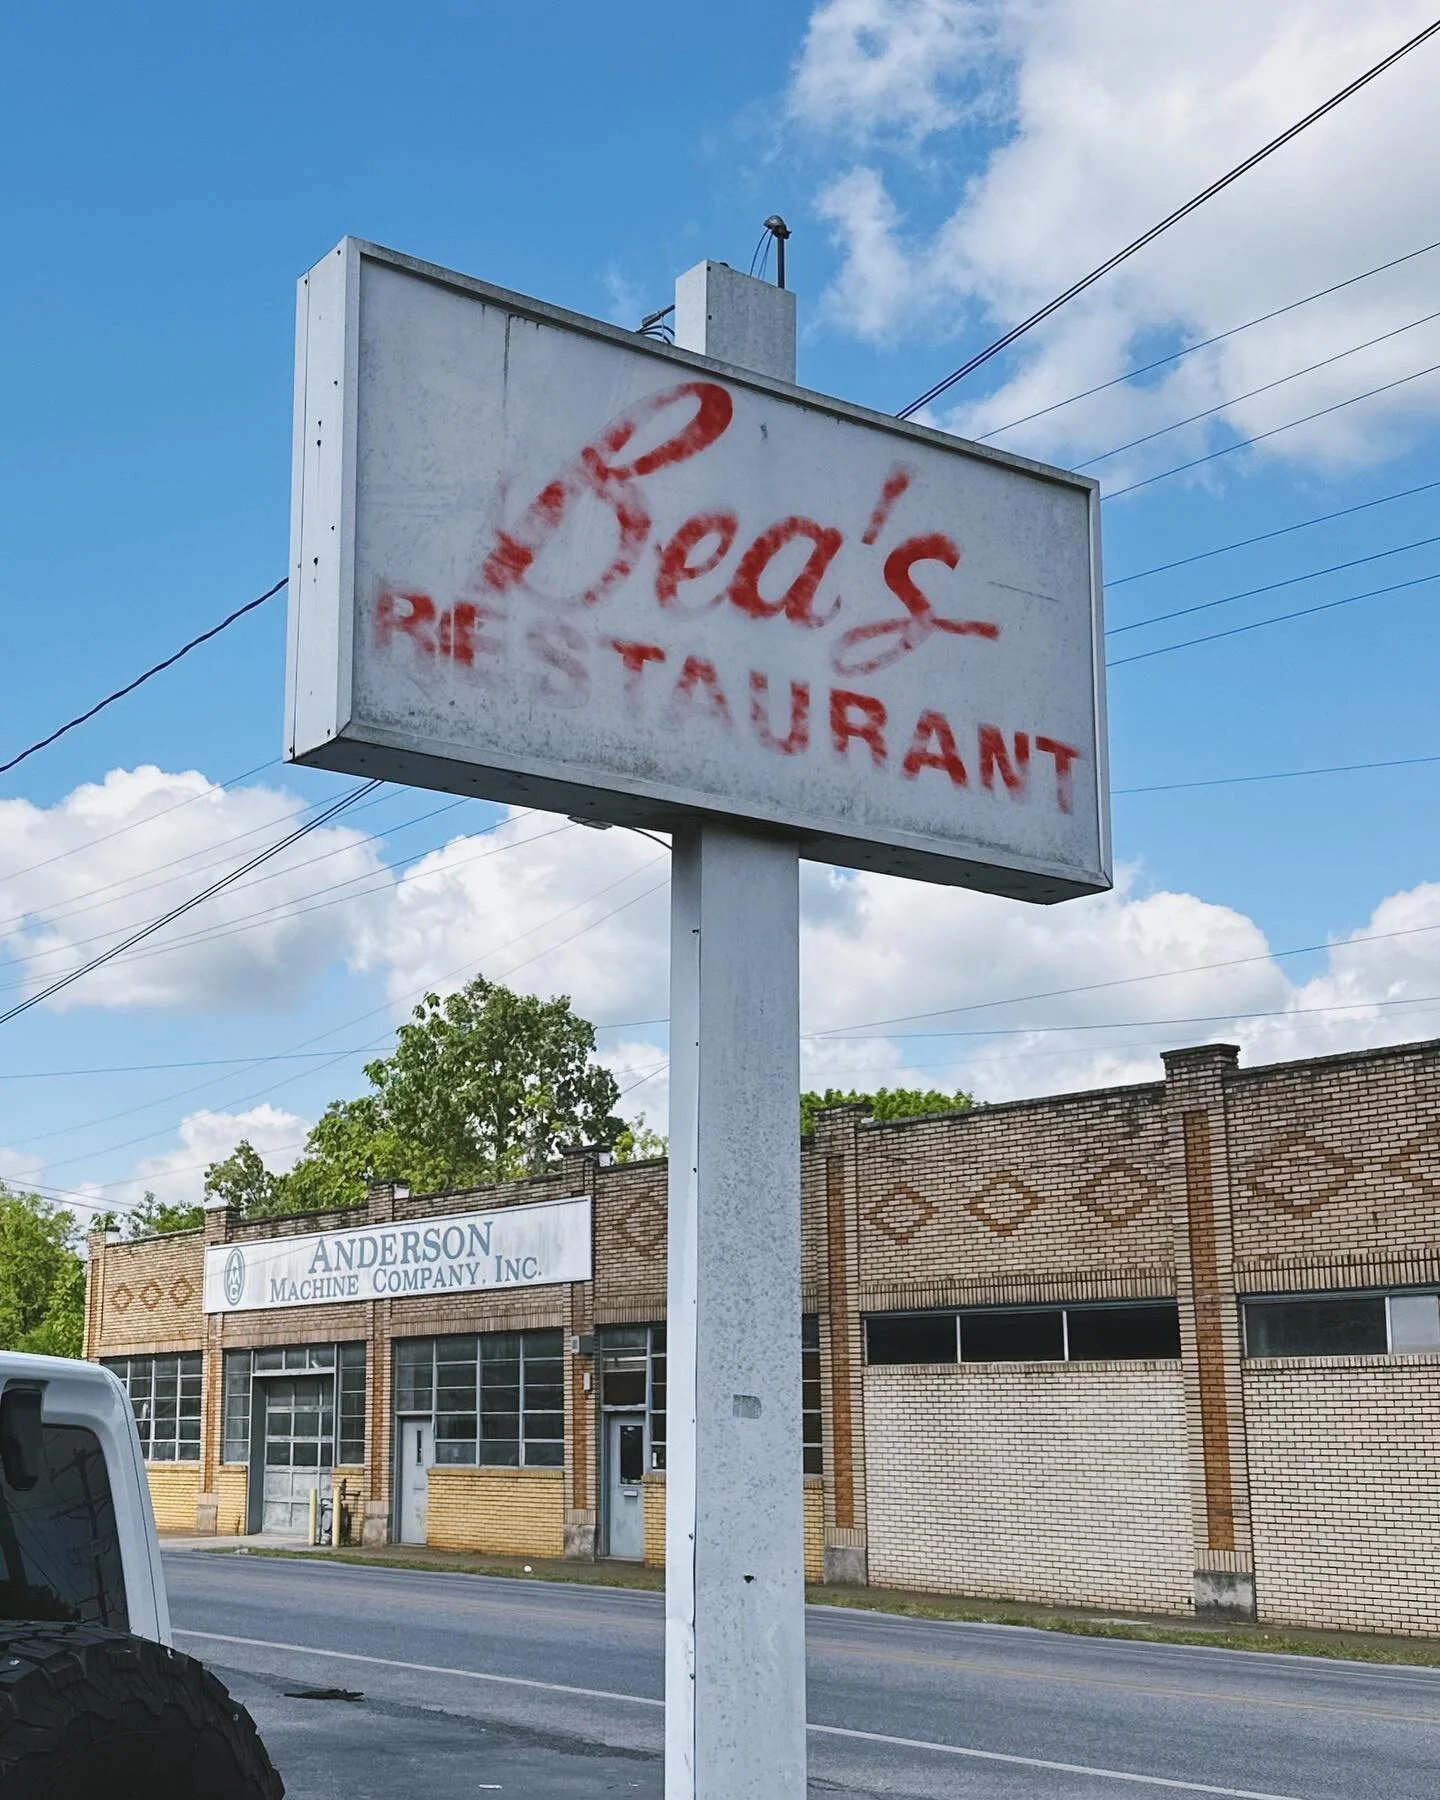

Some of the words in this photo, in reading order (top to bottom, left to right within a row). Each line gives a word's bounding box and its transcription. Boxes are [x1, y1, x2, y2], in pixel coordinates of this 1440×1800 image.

[478, 382, 999, 677] Bea's
[373, 580, 1081, 815] RESTAURANT
[270, 1275, 359, 1303] MACHINE
[495, 1255, 542, 1282] INC.
[308, 1222, 493, 1275] ANDERSON
